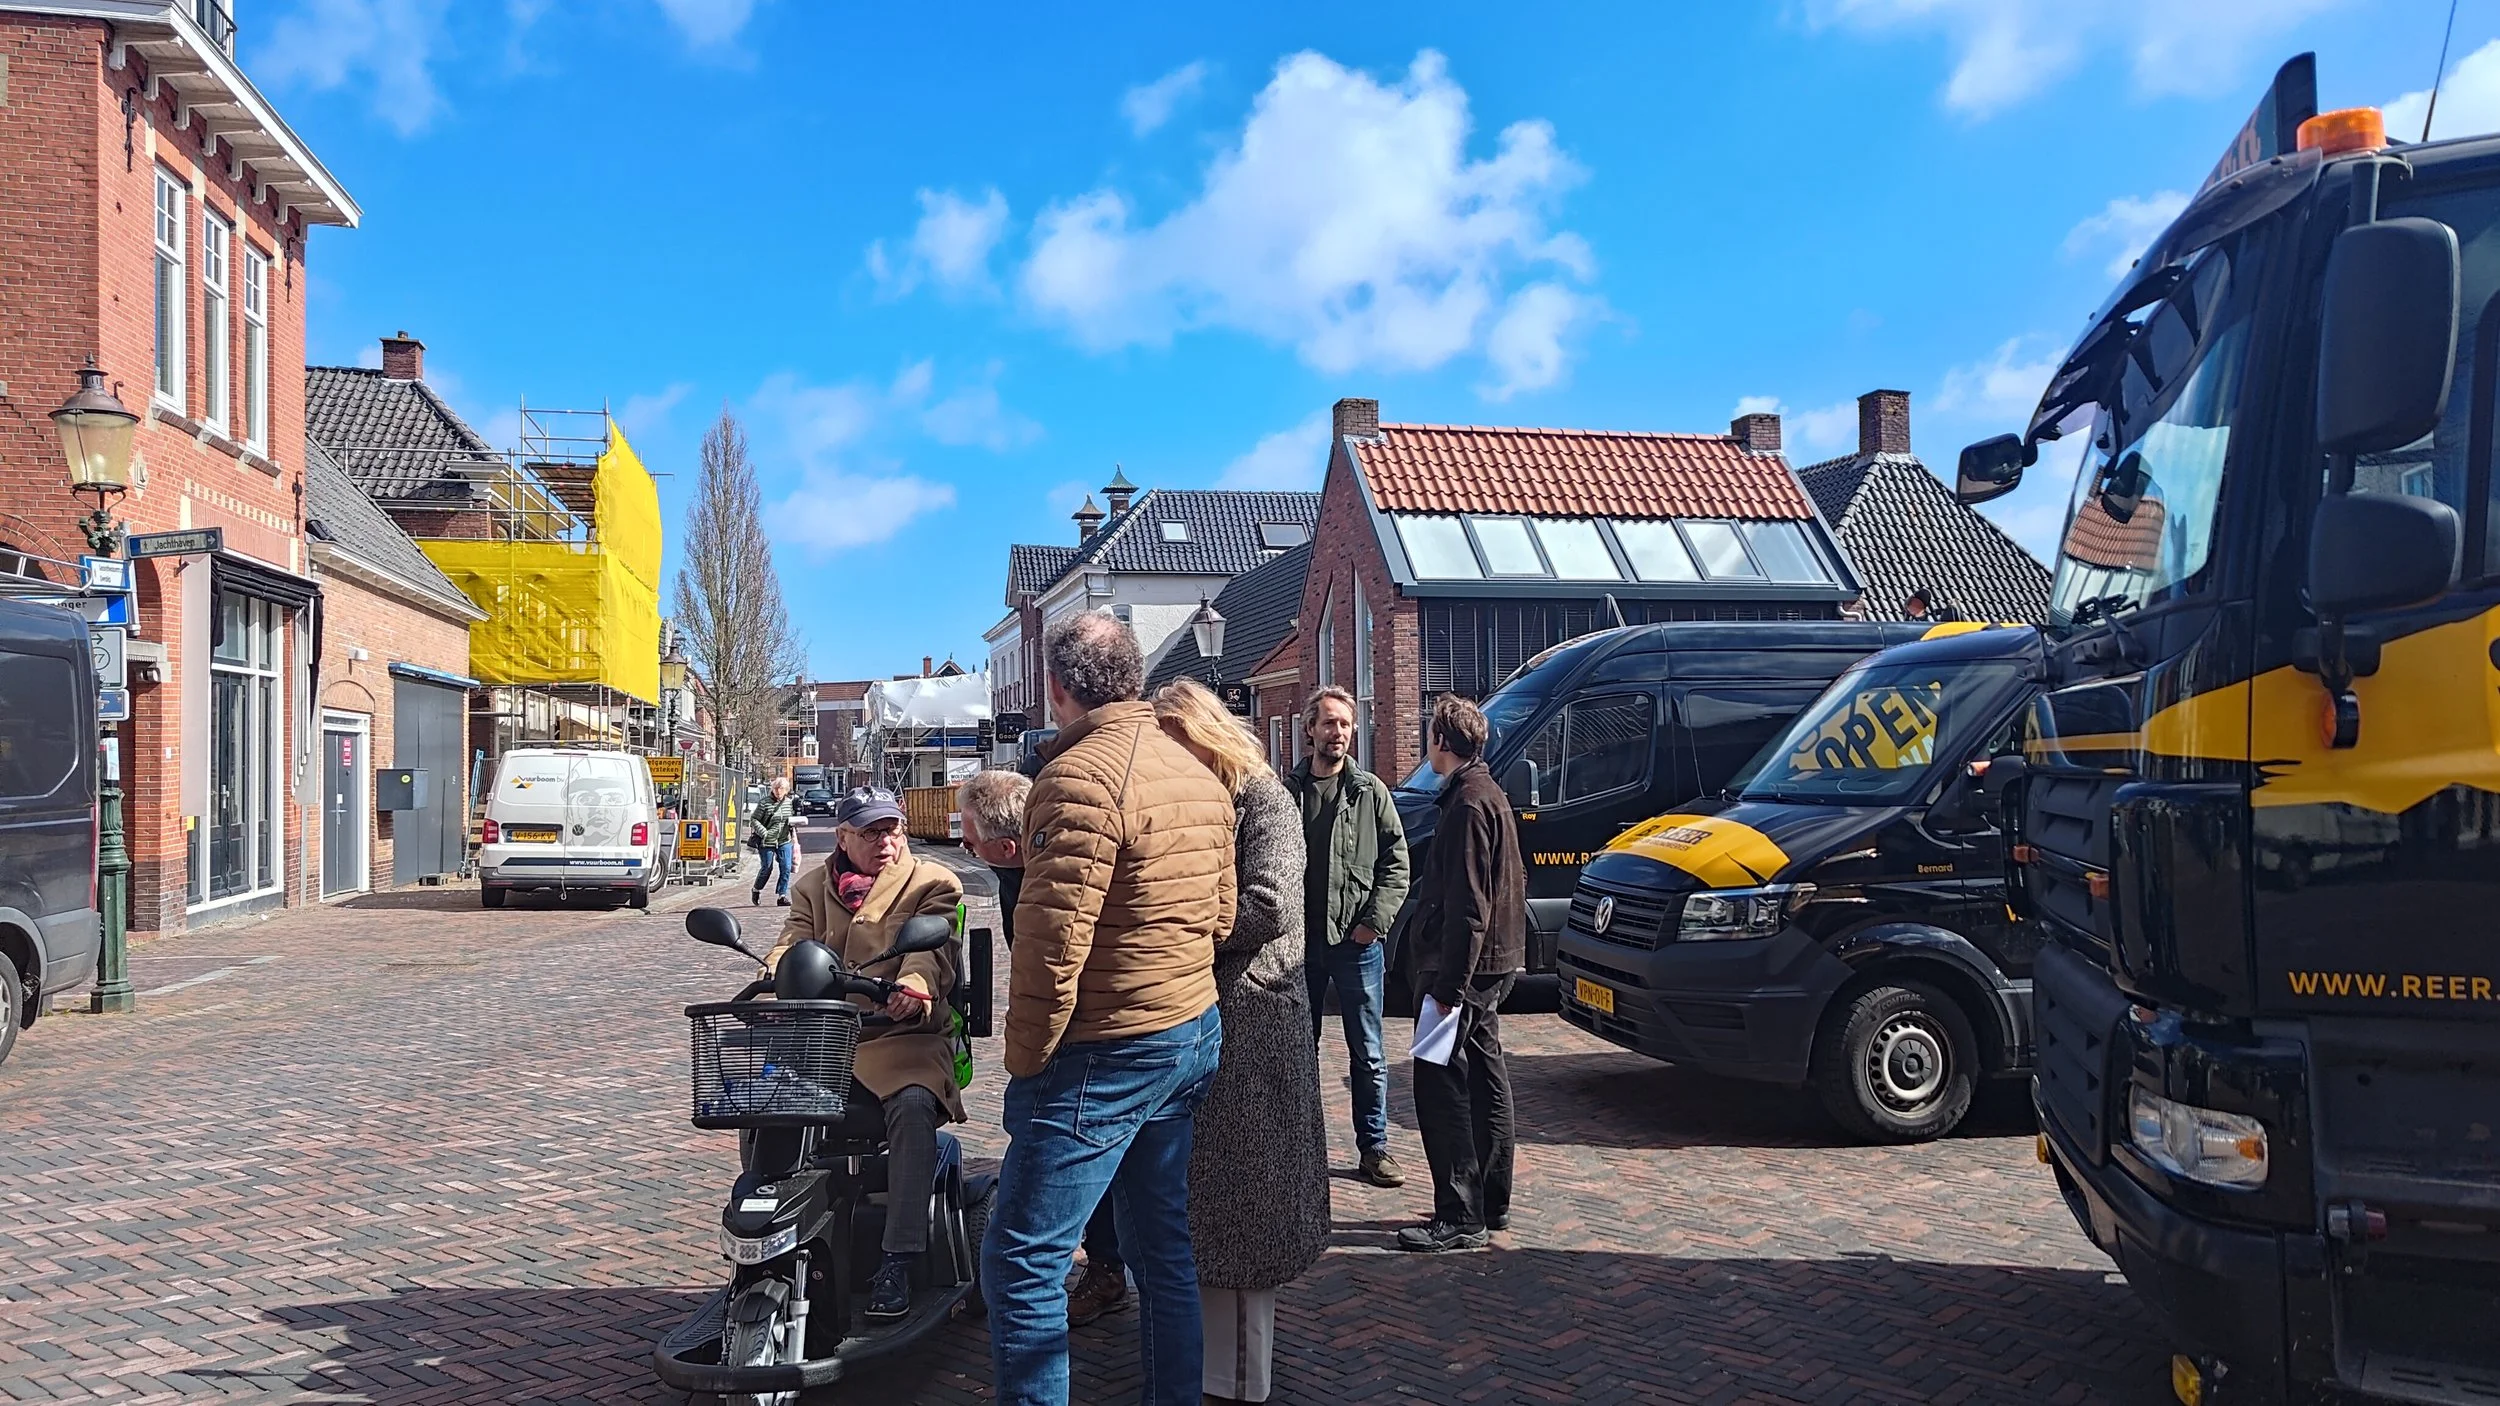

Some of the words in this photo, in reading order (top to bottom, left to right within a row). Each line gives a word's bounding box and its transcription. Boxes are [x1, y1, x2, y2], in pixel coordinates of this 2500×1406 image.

[154, 538, 196, 551] Jachthaven
[647, 759, 682, 769] etgangers
[1521, 813, 1537, 821] Roy
[569, 859, 624, 867] www.vuurboom.nl
[1917, 863, 1954, 874] Bernard
